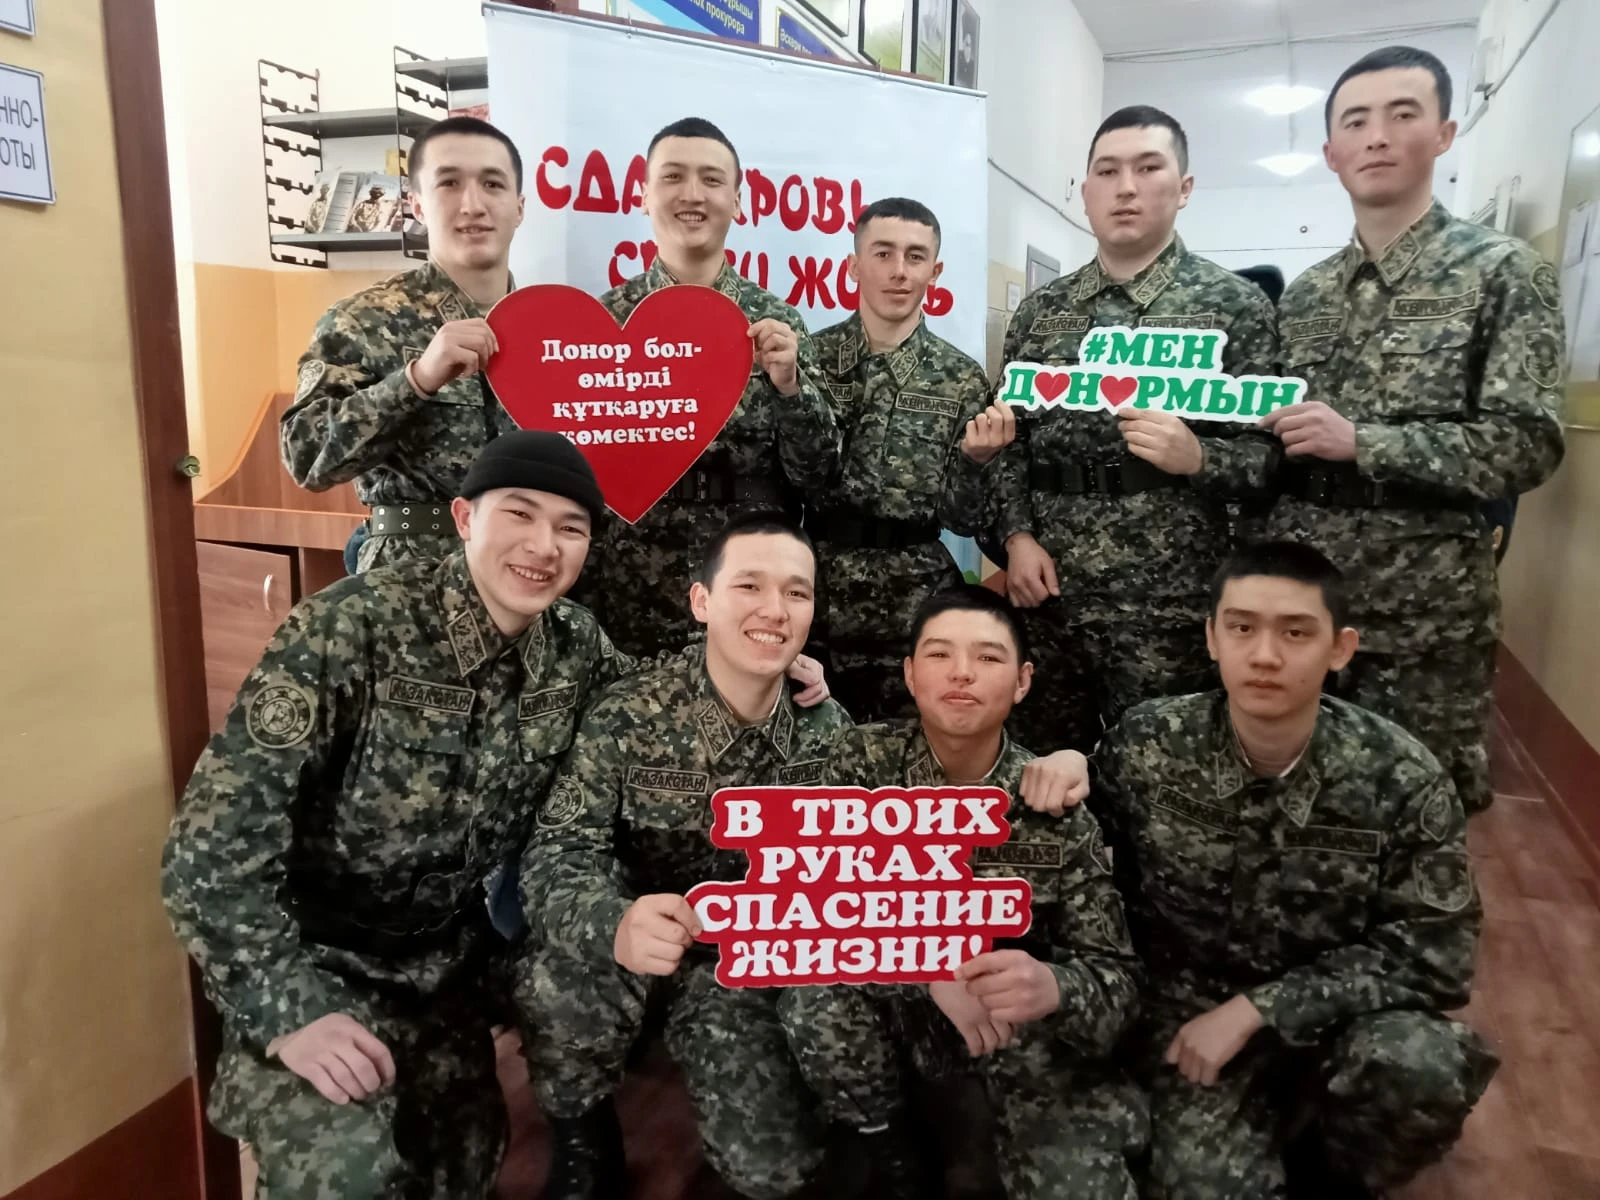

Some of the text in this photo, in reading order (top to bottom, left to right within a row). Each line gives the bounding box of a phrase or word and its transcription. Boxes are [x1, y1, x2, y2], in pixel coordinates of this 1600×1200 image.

[706, 2, 745, 35] прокурора
[536, 146, 646, 215] СДА
[541, 337, 702, 363] Донор бол-
[1083, 332, 1219, 369] #МЕН
[578, 366, 671, 391] өмірді
[551, 397, 698, 421] құтқаруға
[724, 798, 1000, 837] В ТВОИХ
[759, 845, 963, 883] РУКАХ
[695, 889, 1023, 932] СПАСЕНИЕ
